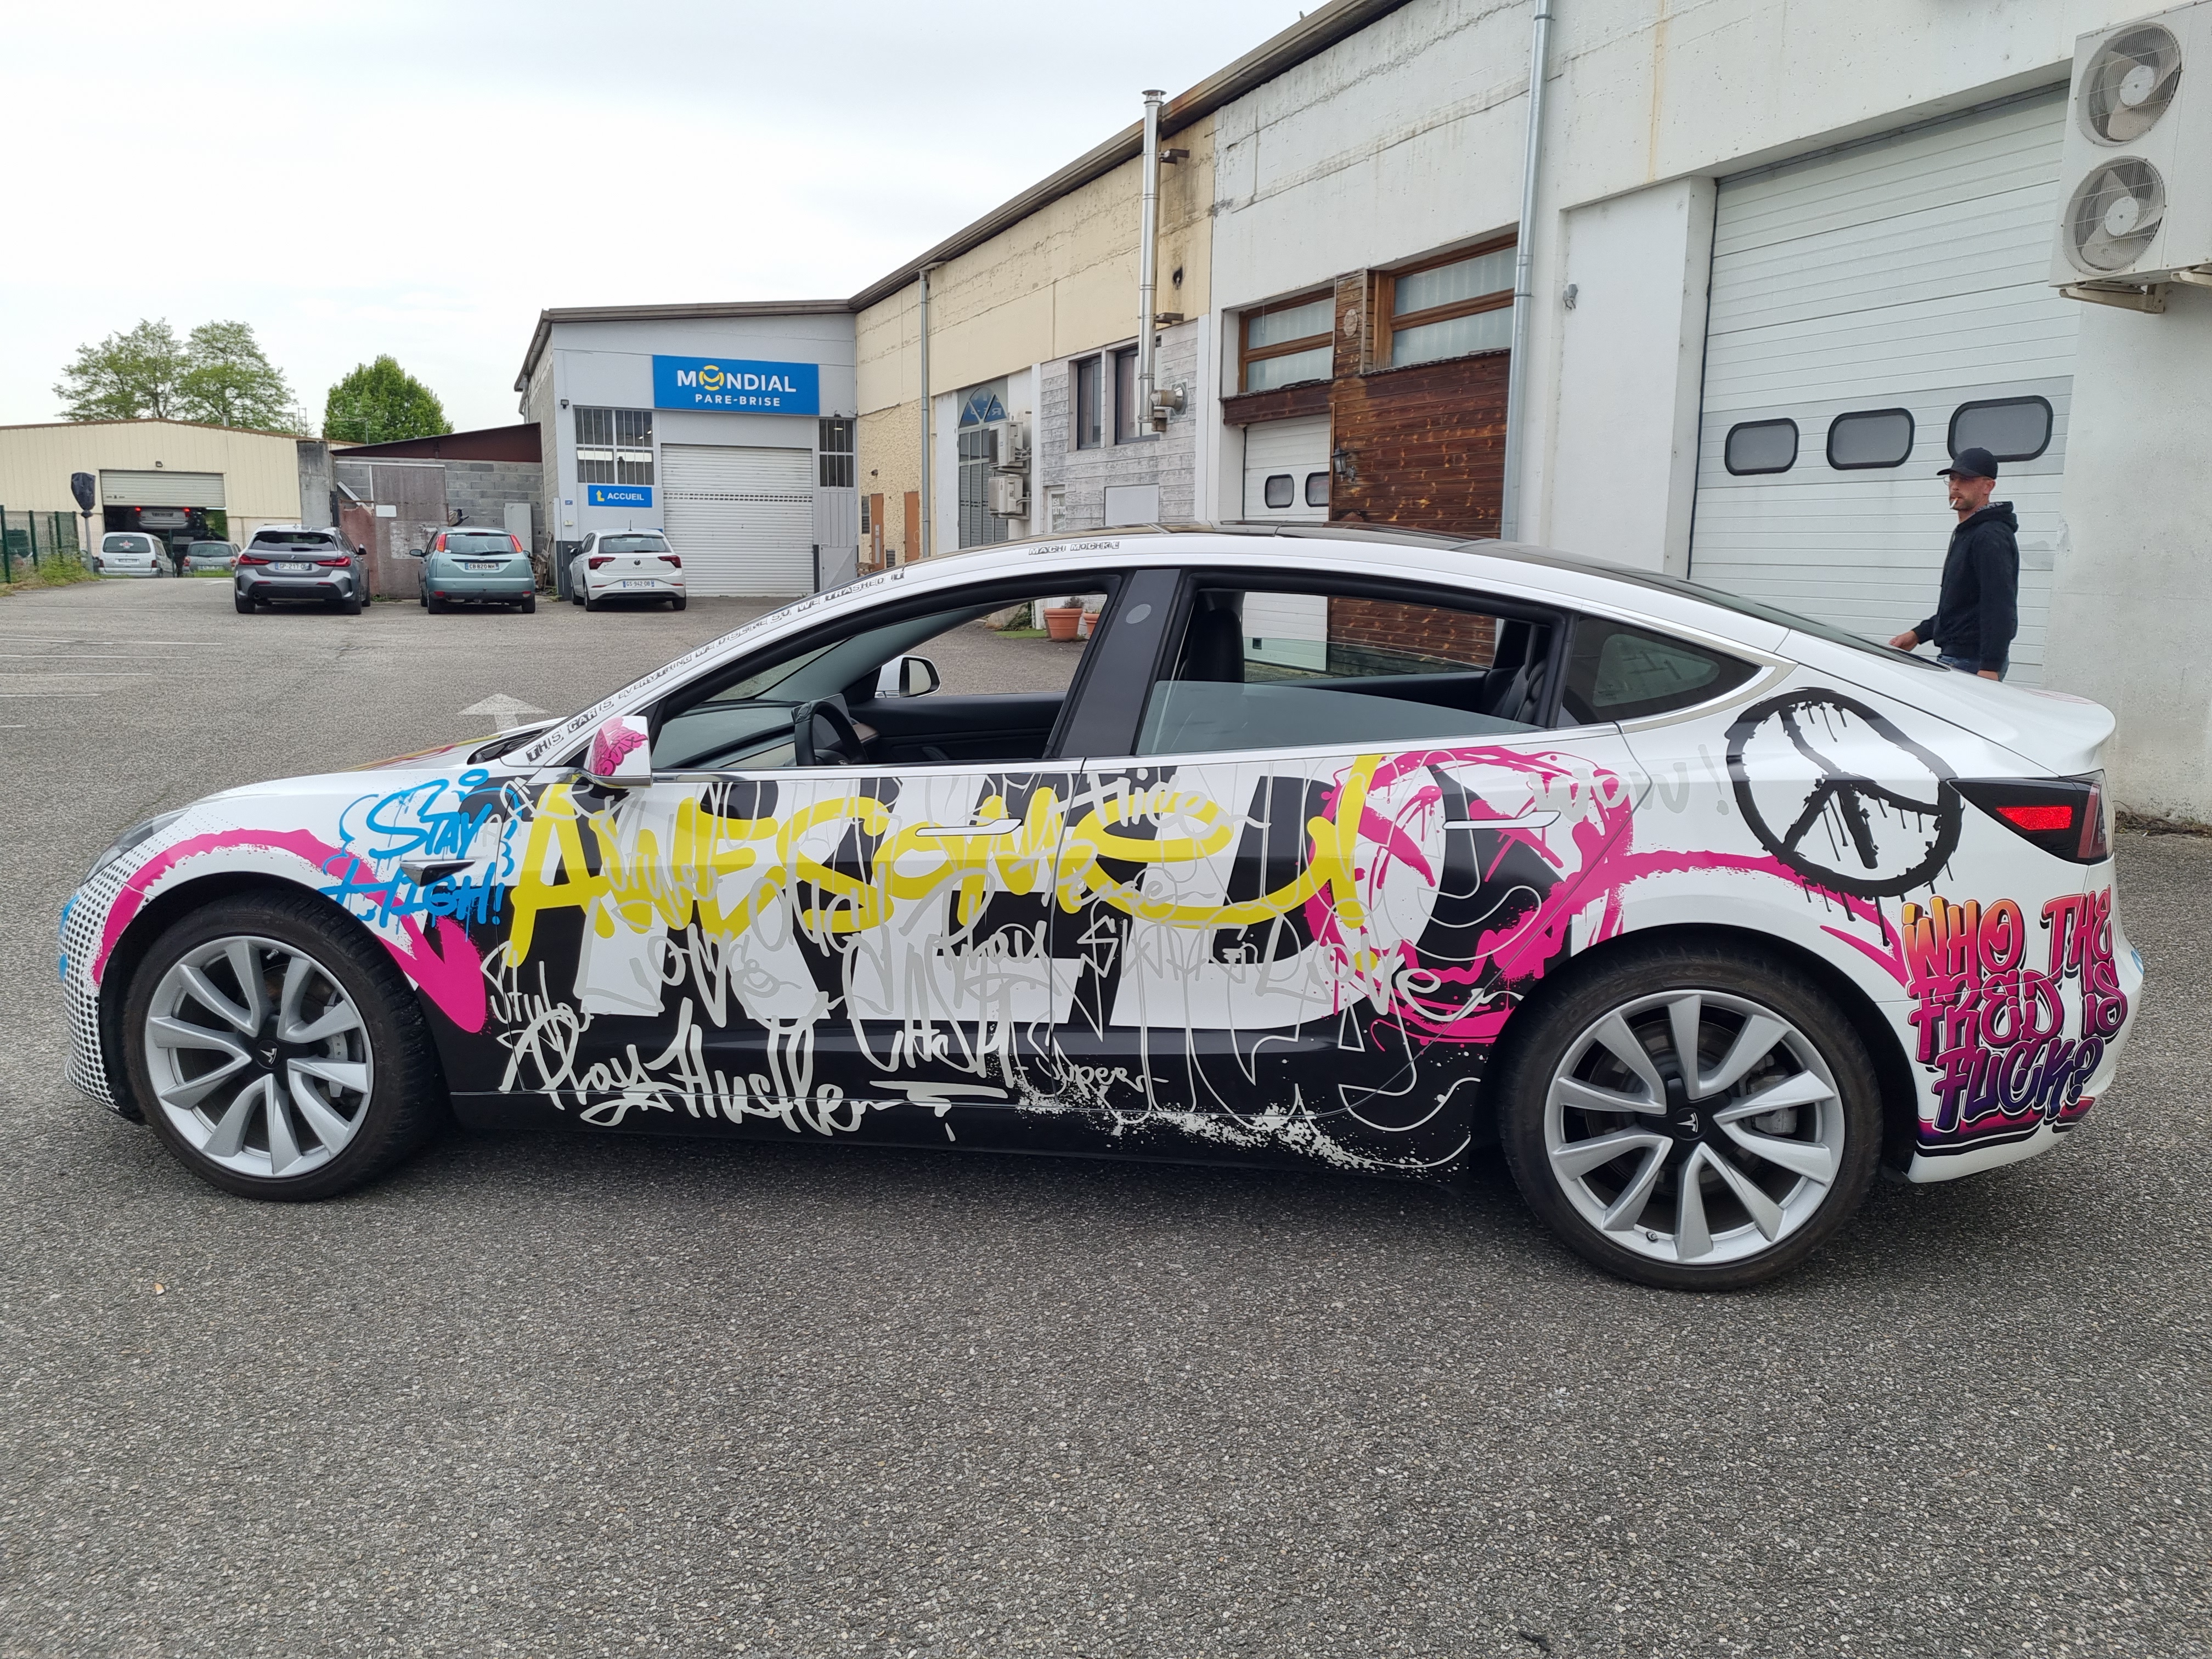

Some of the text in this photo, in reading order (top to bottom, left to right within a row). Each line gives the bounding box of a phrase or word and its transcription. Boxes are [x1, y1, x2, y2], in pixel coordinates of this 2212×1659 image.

[677, 365, 797, 392] MONDIAL
[695, 393, 781, 407] PARE-BRISE
[607, 492, 645, 501] ACCUEIL
[526, 728, 564, 764] THIS
[567, 709, 598, 735] CAR
[599, 697, 614, 713] IS
[618, 654, 692, 700] EVERYTHING
[695, 641, 715, 658] WE
[770, 607, 792, 624] SO
[797, 596, 821, 614] WE
[823, 574, 887, 603] TRASHED
[890, 570, 905, 583] IT
[1901, 895, 2026, 979] WHO
[1931, 1037, 2106, 1133] FUCK?
